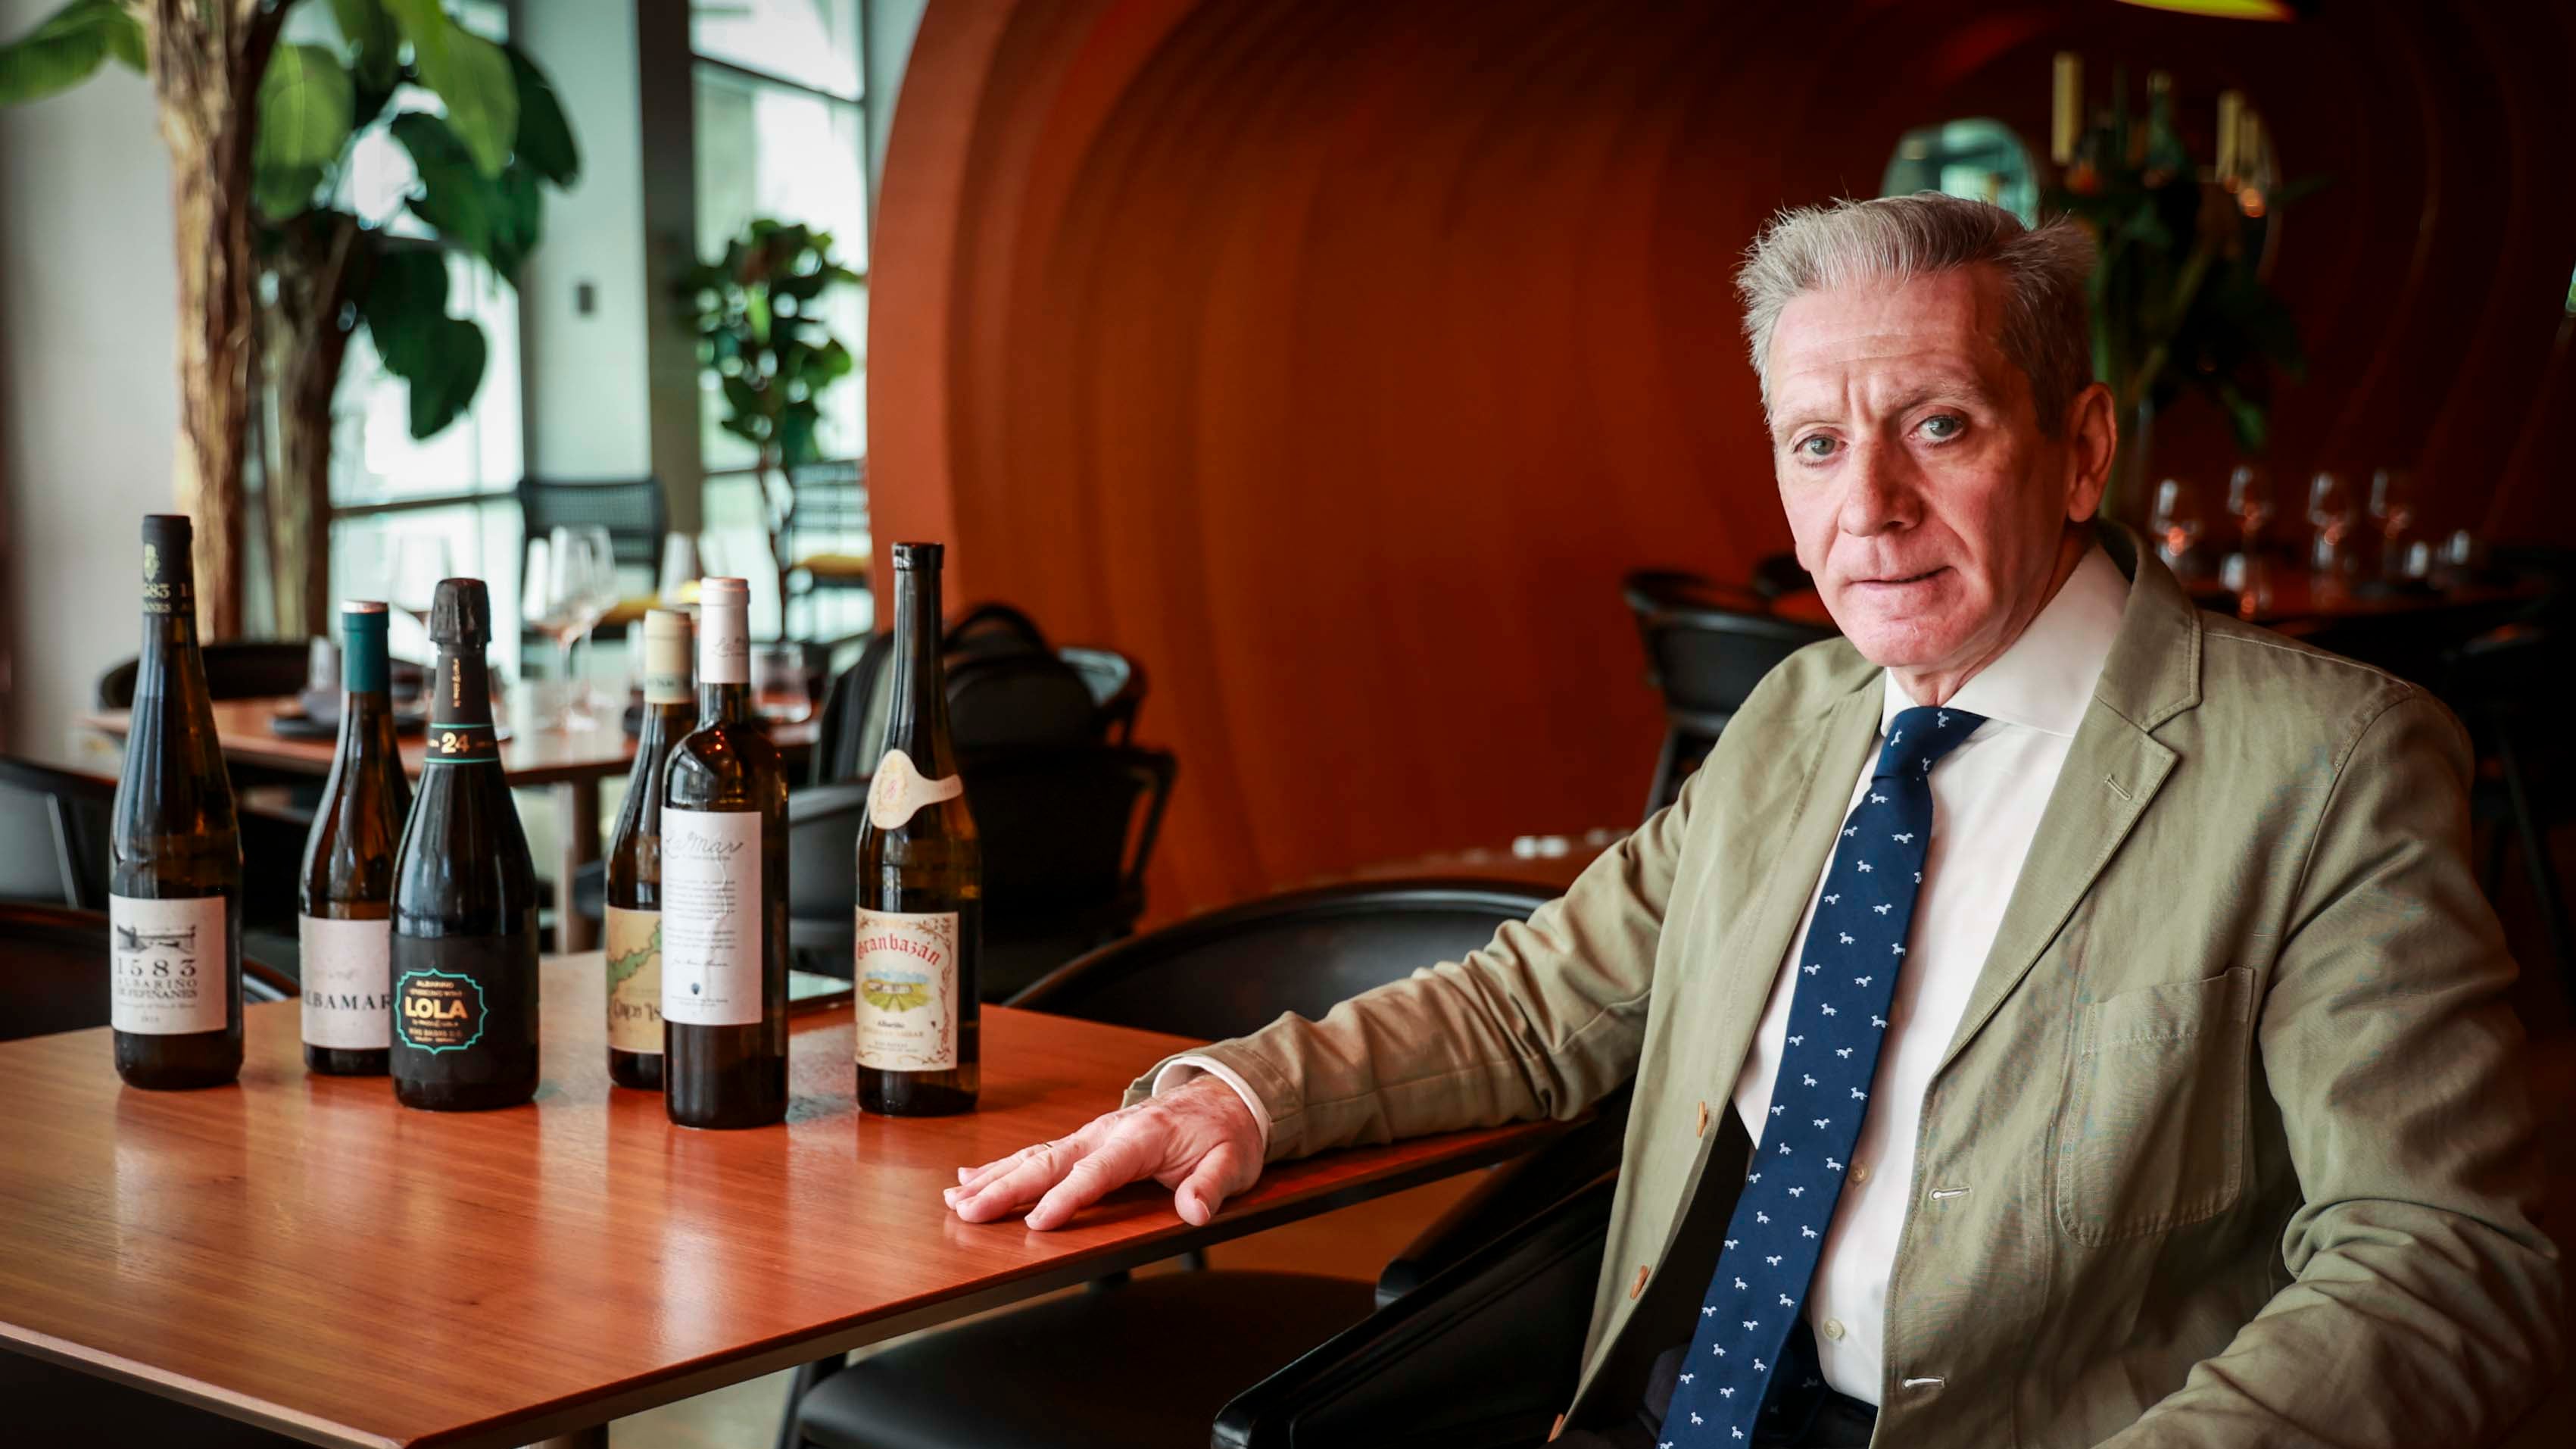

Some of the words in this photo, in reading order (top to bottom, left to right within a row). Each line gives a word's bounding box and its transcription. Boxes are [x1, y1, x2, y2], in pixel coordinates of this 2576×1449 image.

[441, 732, 469, 754] 24
[117, 957, 197, 977] 1583
[404, 996, 469, 1019] LOLA
